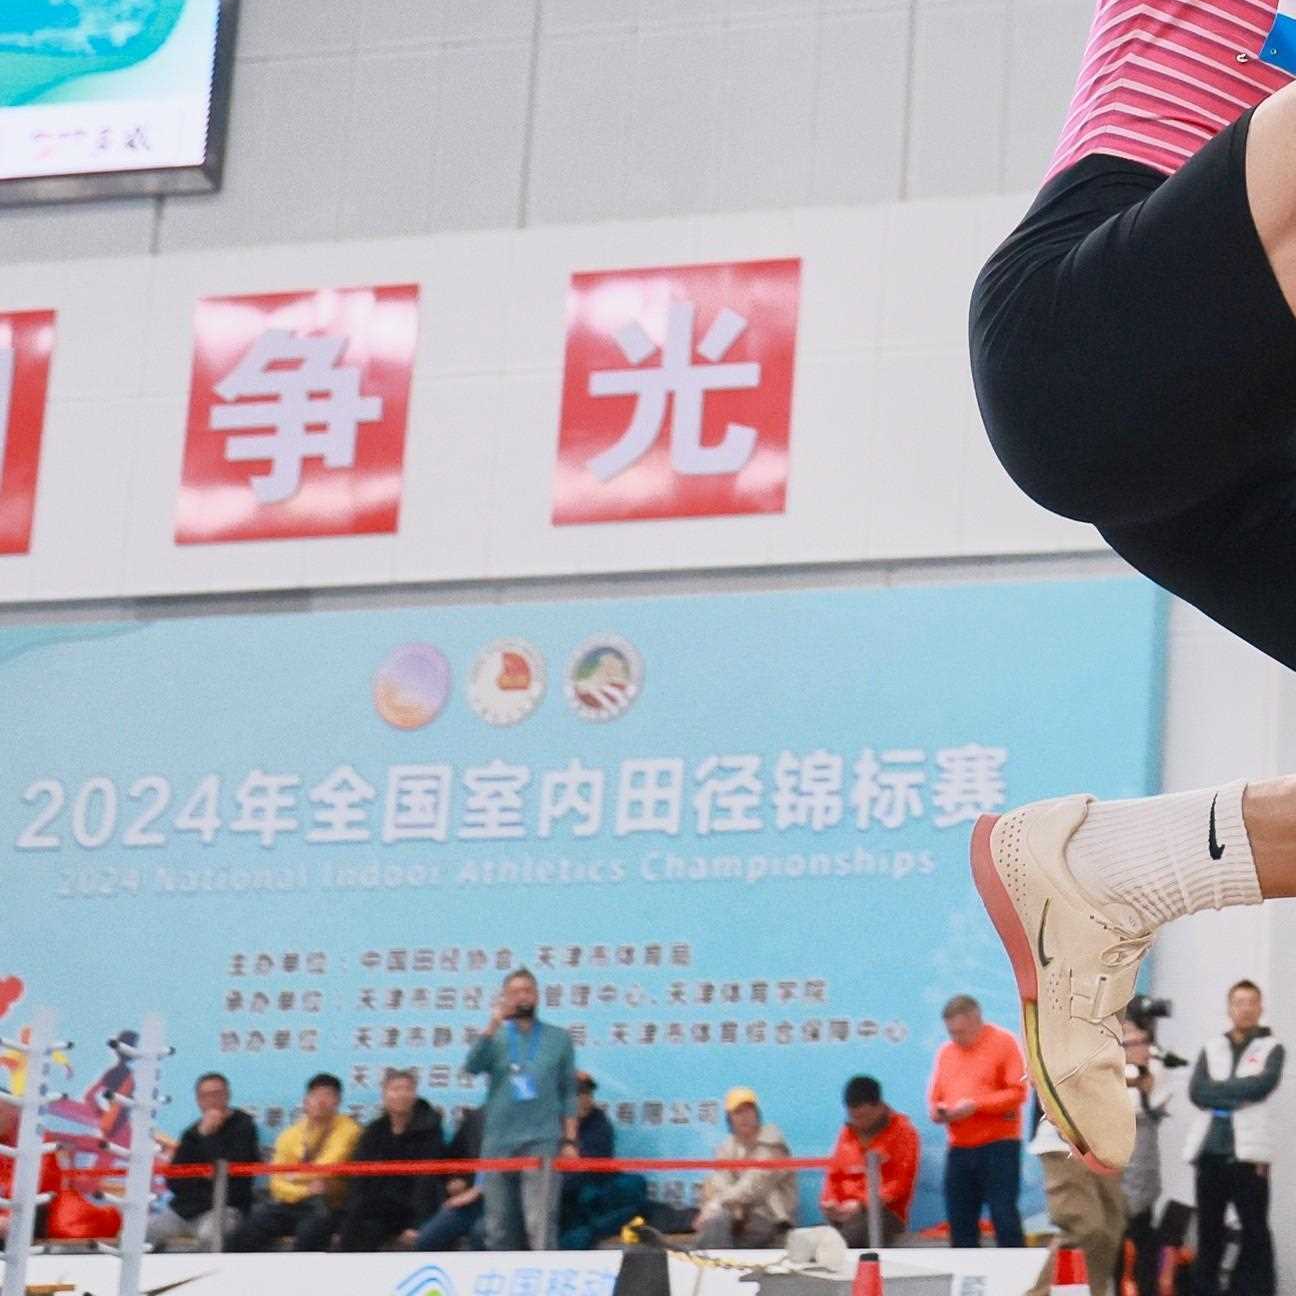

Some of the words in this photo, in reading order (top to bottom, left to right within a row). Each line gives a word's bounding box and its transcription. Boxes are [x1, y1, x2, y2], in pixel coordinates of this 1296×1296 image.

[15, 743, 1008, 850] 2024年全国室内田径锦标赛
[57, 866, 142, 896] 2024
[153, 861, 307, 893] National
[320, 859, 440, 889] Indoor
[456, 854, 626, 885] Athletics
[640, 846, 937, 884] Championships
